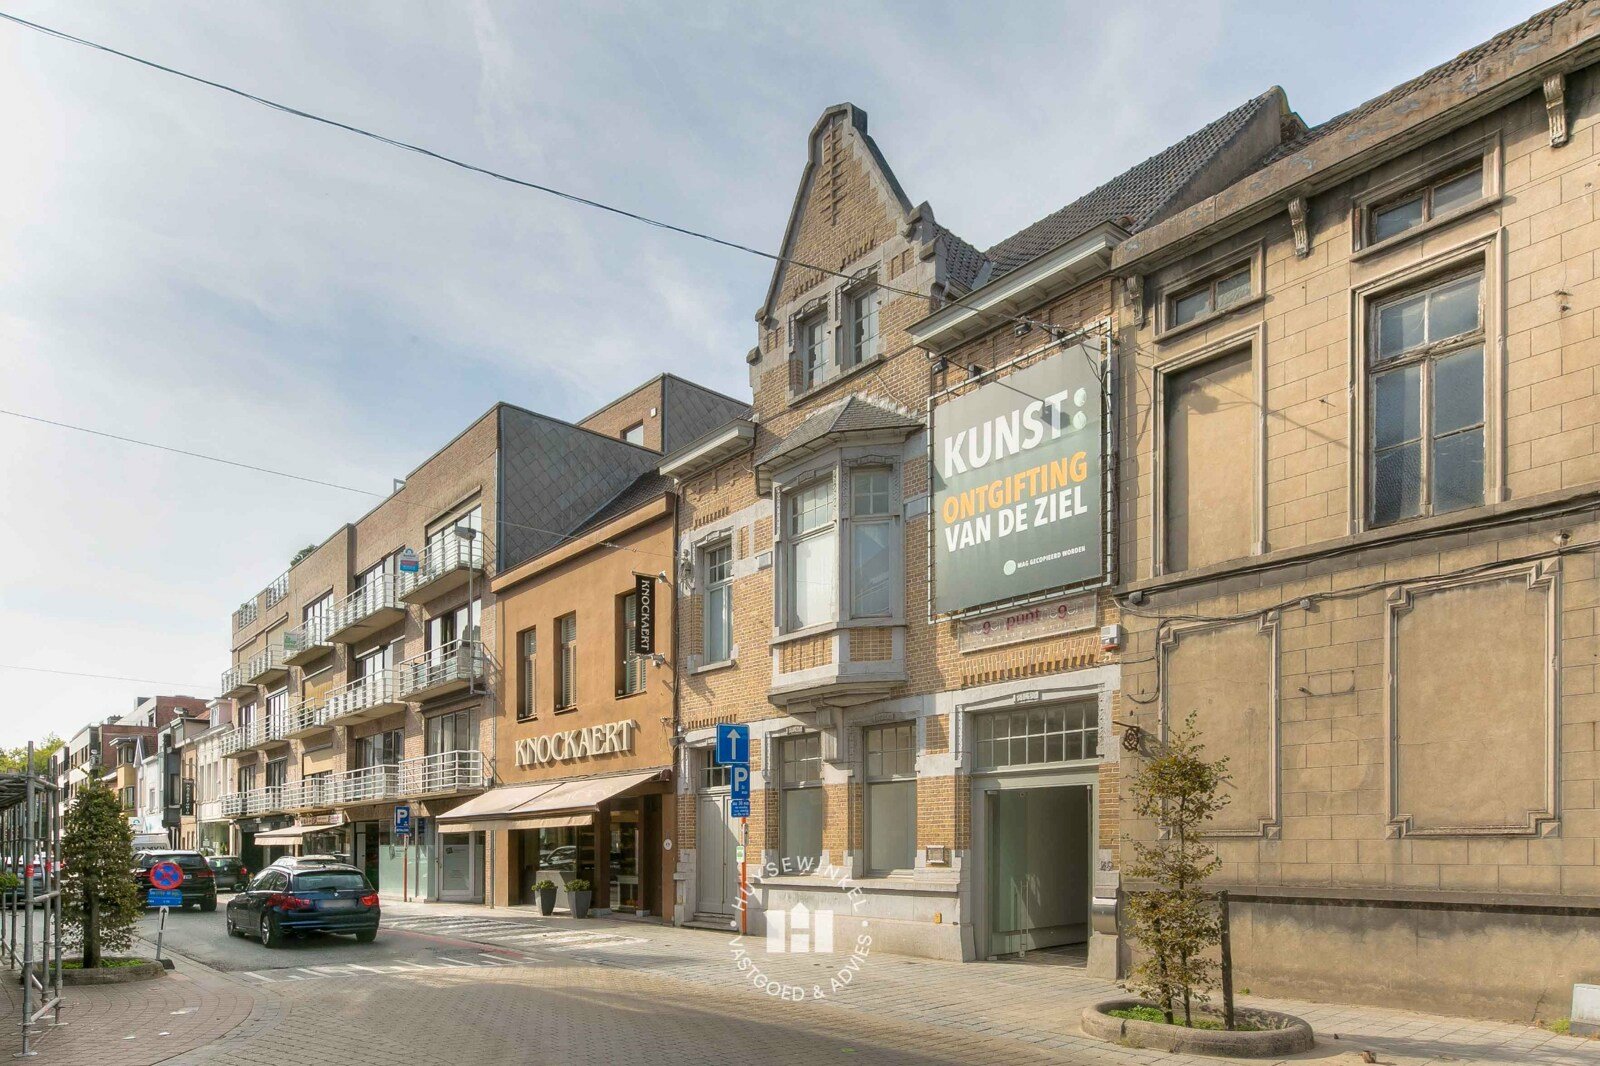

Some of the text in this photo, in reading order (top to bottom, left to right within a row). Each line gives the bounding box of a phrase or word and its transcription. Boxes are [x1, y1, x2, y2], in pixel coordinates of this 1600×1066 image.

[944, 387, 1088, 479] KUNST:
[943, 451, 1088, 525] ONTGIFTING
[945, 485, 1088, 553] VAN DE ZIEL
[1017, 545, 1086, 568] MAG GECOPIEERD WORDEN
[640, 579, 650, 651] KNOCKAERT
[1006, 607, 1040, 631] punt
[514, 719, 636, 767] KNOCKAERT
[734, 767, 748, 792] P
[396, 809, 408, 824] P
